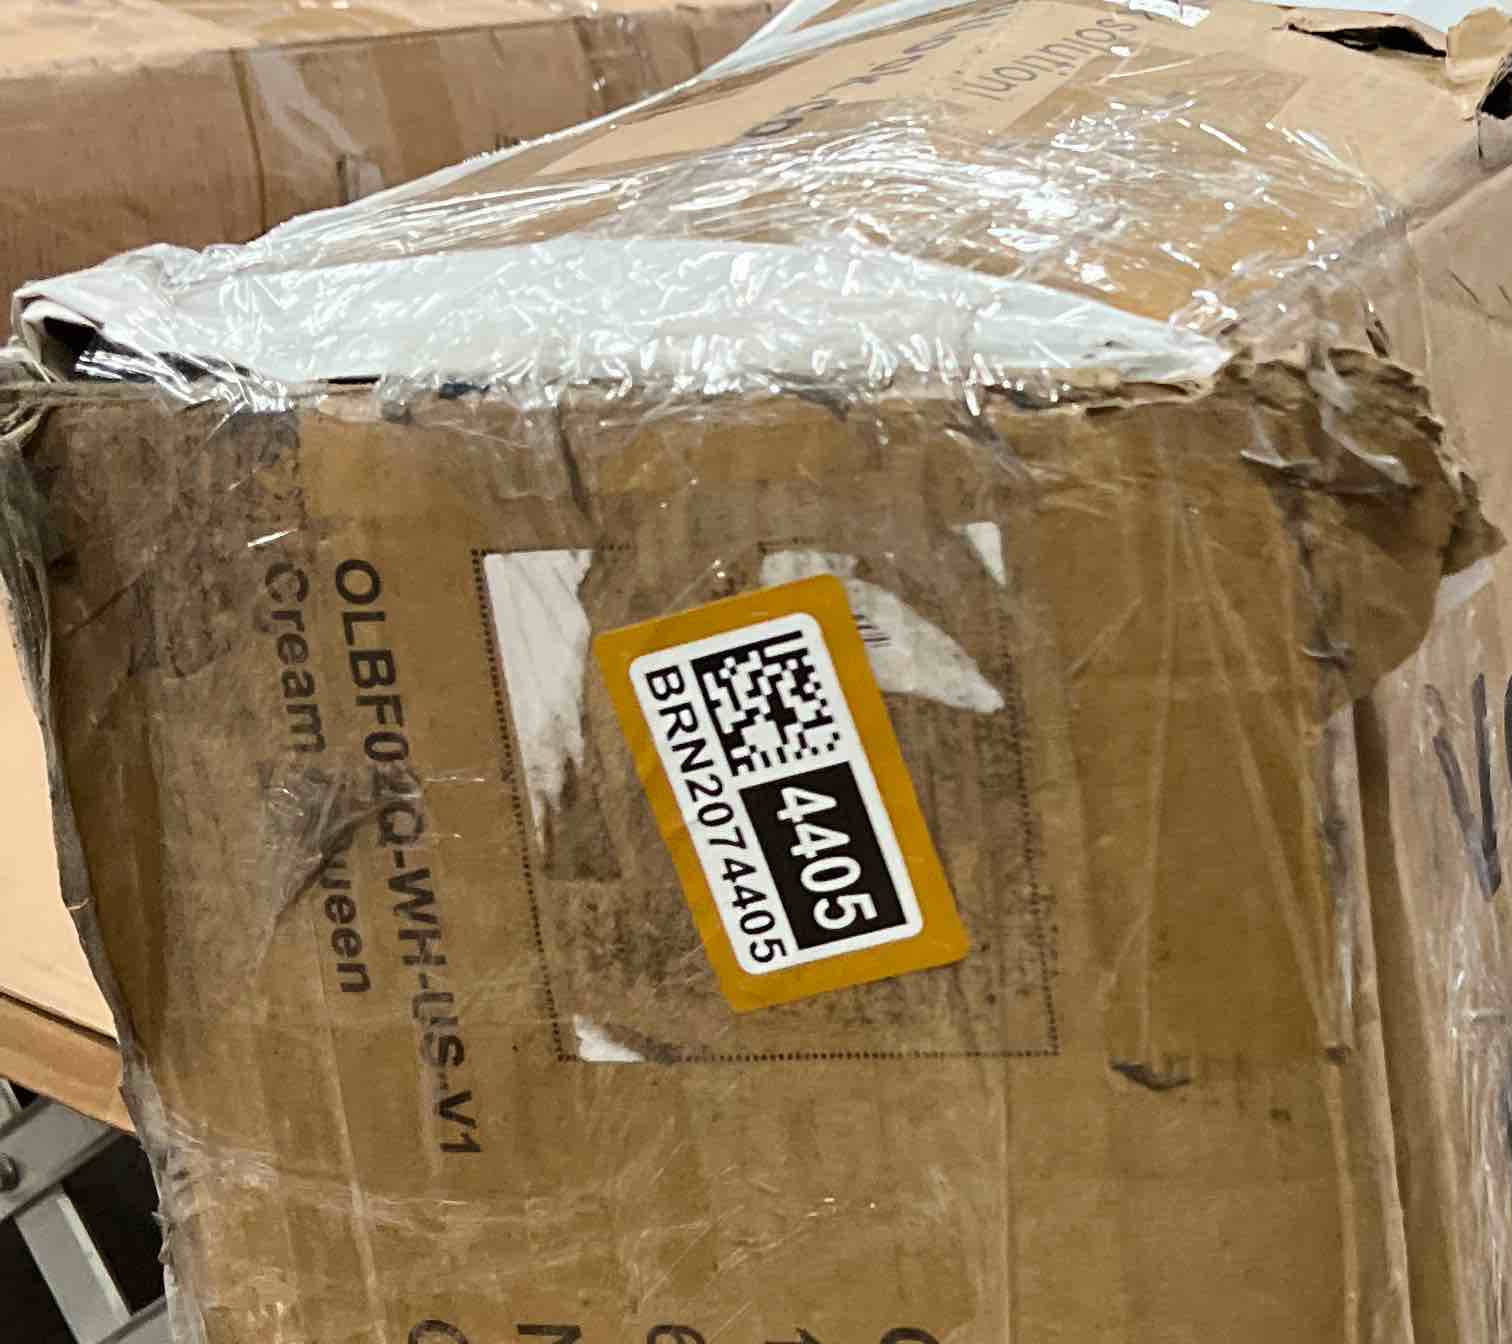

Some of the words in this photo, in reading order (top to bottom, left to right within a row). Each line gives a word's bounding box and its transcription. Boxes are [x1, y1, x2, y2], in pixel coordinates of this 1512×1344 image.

[264, 561, 329, 754] Cream
[644, 665, 788, 965] BRN2074405
[777, 787, 879, 930] 4405
